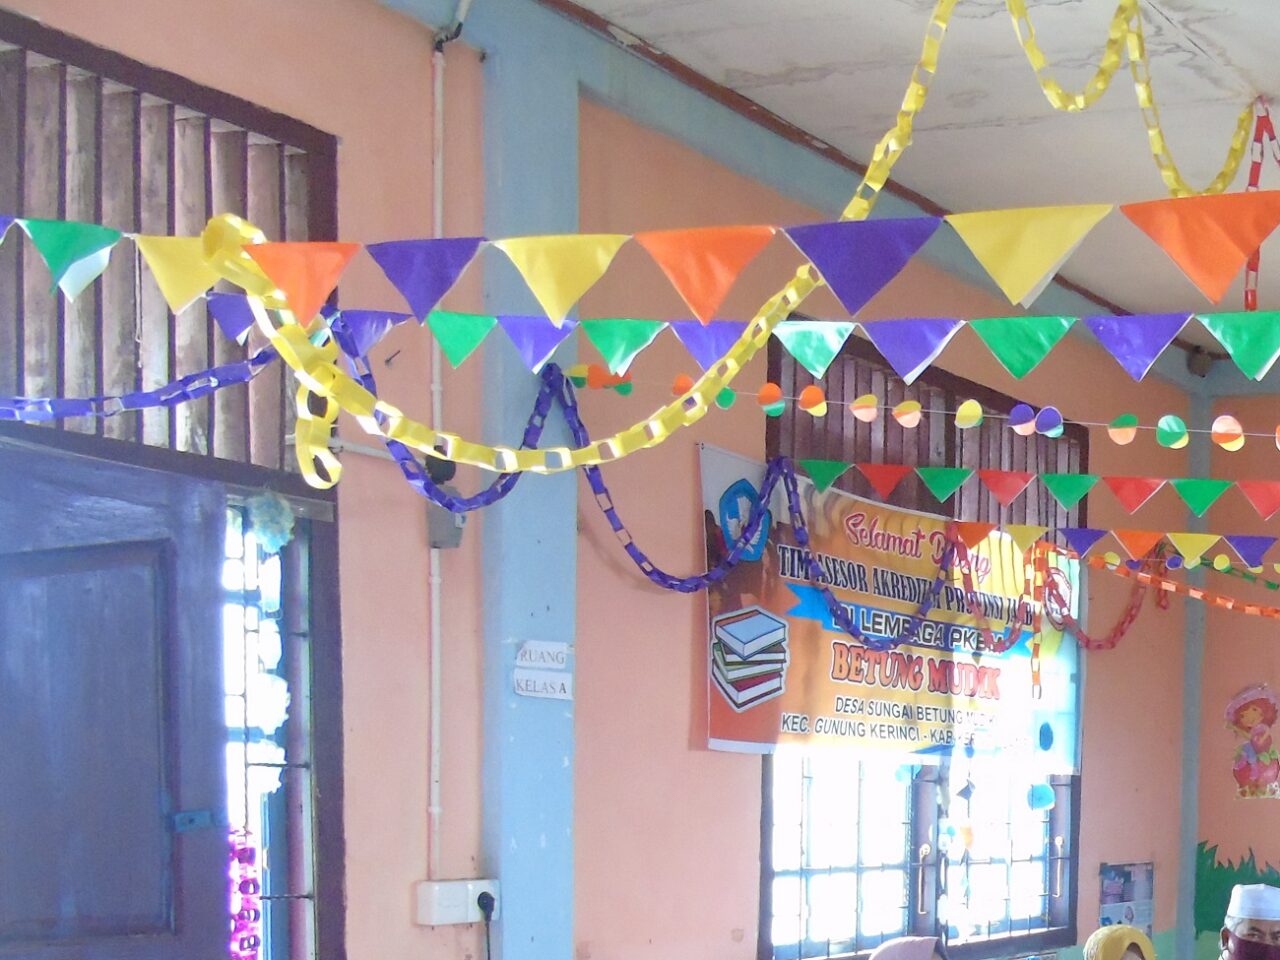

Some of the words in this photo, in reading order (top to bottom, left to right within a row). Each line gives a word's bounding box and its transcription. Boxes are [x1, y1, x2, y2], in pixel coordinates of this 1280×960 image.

[845, 513, 926, 559] Selamat
[779, 545, 811, 580] TIM
[817, 553, 868, 592] ASESOR
[520, 649, 564, 664] RUANG
[832, 642, 924, 691] BETUNG
[927, 658, 1000, 700] MUDIK
[516, 679, 556, 694] KELAS
[558, 682, 567, 694] A
[836, 697, 864, 714] DESA
[867, 700, 913, 720] SUNGAI
[916, 706, 963, 724] BETUNG
[782, 714, 811, 733] KEC.
[814, 718, 866, 738] GUNUNG
[870, 724, 920, 741] KERINCI
